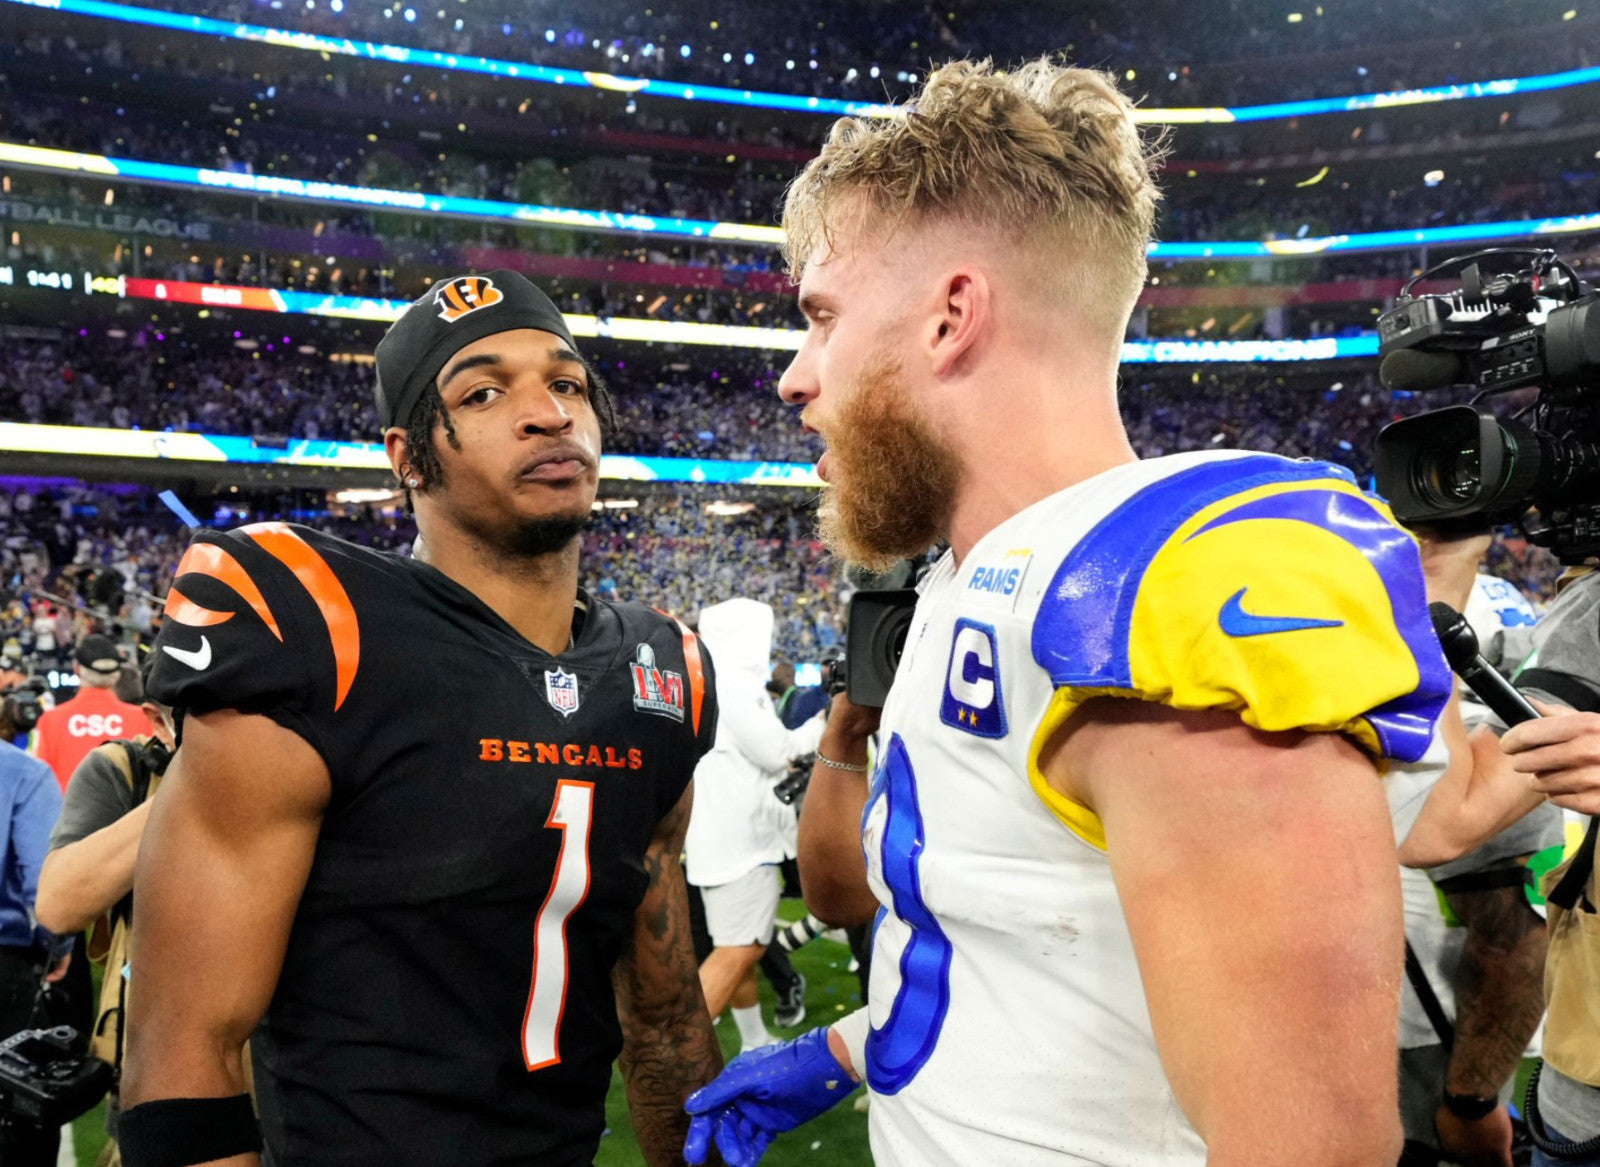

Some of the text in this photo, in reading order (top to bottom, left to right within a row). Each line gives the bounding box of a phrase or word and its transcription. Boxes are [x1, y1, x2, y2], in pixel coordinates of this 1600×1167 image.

[96, 214, 211, 240] LEAGUE
[1509, 328, 1536, 341] SONY
[968, 566, 1020, 595] RAMS
[949, 627, 995, 710] C
[552, 687, 576, 709] NFL
[68, 714, 123, 737] CSC
[479, 738, 643, 770] BENGALS
[521, 779, 595, 1072] 1
